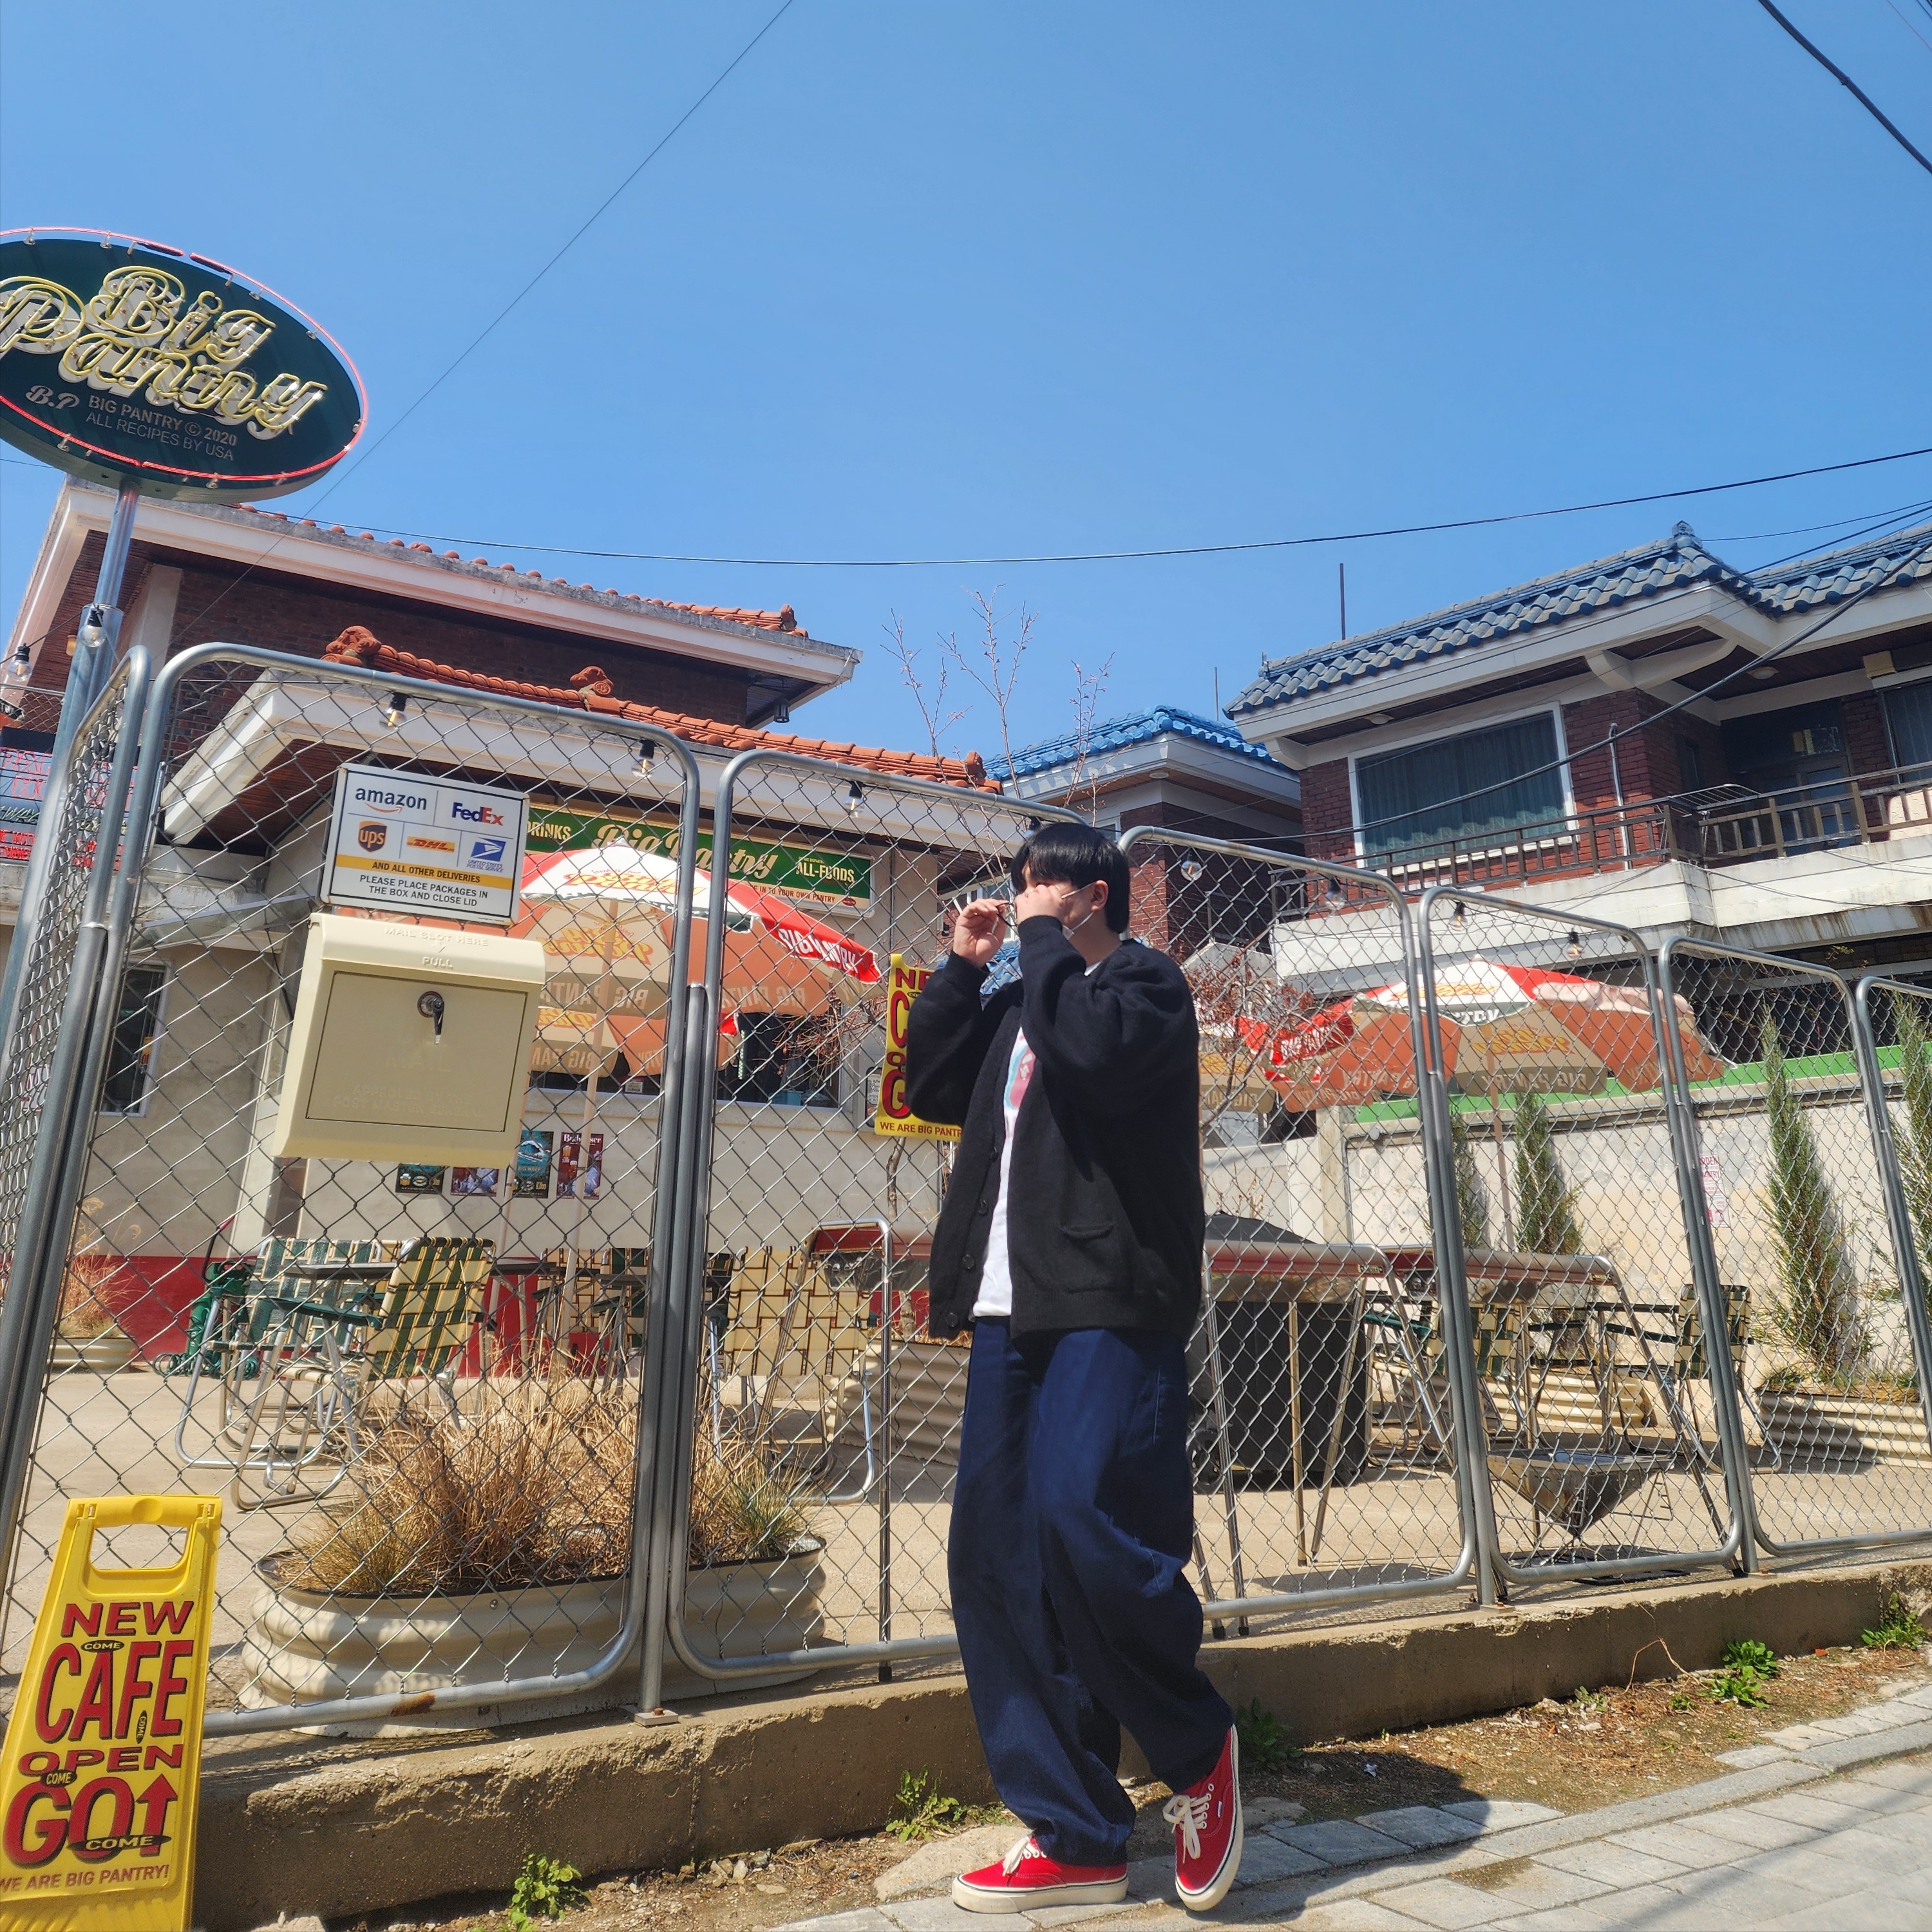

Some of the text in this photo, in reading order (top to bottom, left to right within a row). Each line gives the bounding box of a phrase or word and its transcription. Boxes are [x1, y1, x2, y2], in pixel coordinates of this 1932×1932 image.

[87, 265, 277, 370] Big
[0, 276, 328, 440] Pantry
[88, 394, 117, 414] BIG
[120, 404, 184, 435] PANTRY
[204, 427, 238, 447] 2020
[86, 412, 234, 461] ALL RECIPES BY USA
[355, 787, 504, 826] amazon FedEx
[359, 829, 448, 850] ups DHL
[372, 861, 480, 883] AND ALL OTHER DELIVERIES
[796, 861, 855, 883] ALL-FOODS
[359, 875, 488, 899] PLEASE PLACE PACKAGES IN
[369, 886, 477, 907] THE BOX AND CLOSE LID
[777, 888, 795, 898] YOUR
[796, 891, 811, 900] OWN
[812, 893, 835, 903] PANTRY
[384, 926, 489, 947] MAIL SLOT HERE
[422, 956, 453, 970] PULL
[895, 967, 933, 990] NE
[880, 1121, 895, 1132] WE
[897, 1122, 916, 1133] ARE
[918, 1125, 933, 1135] BIG
[61, 1600, 194, 1638] NEW
[84, 1641, 122, 1652] COME
[35, 1640, 194, 1744] CAFE
[136, 1715, 146, 1741] COME
[17, 1744, 184, 1776] OPEN
[46, 1770, 72, 1785] COME
[86, 1834, 153, 1850] COME
[24, 1873, 62, 1891] ARE
[65, 1871, 95, 1888] BIG
[99, 1864, 169, 1885] PANTRY!
